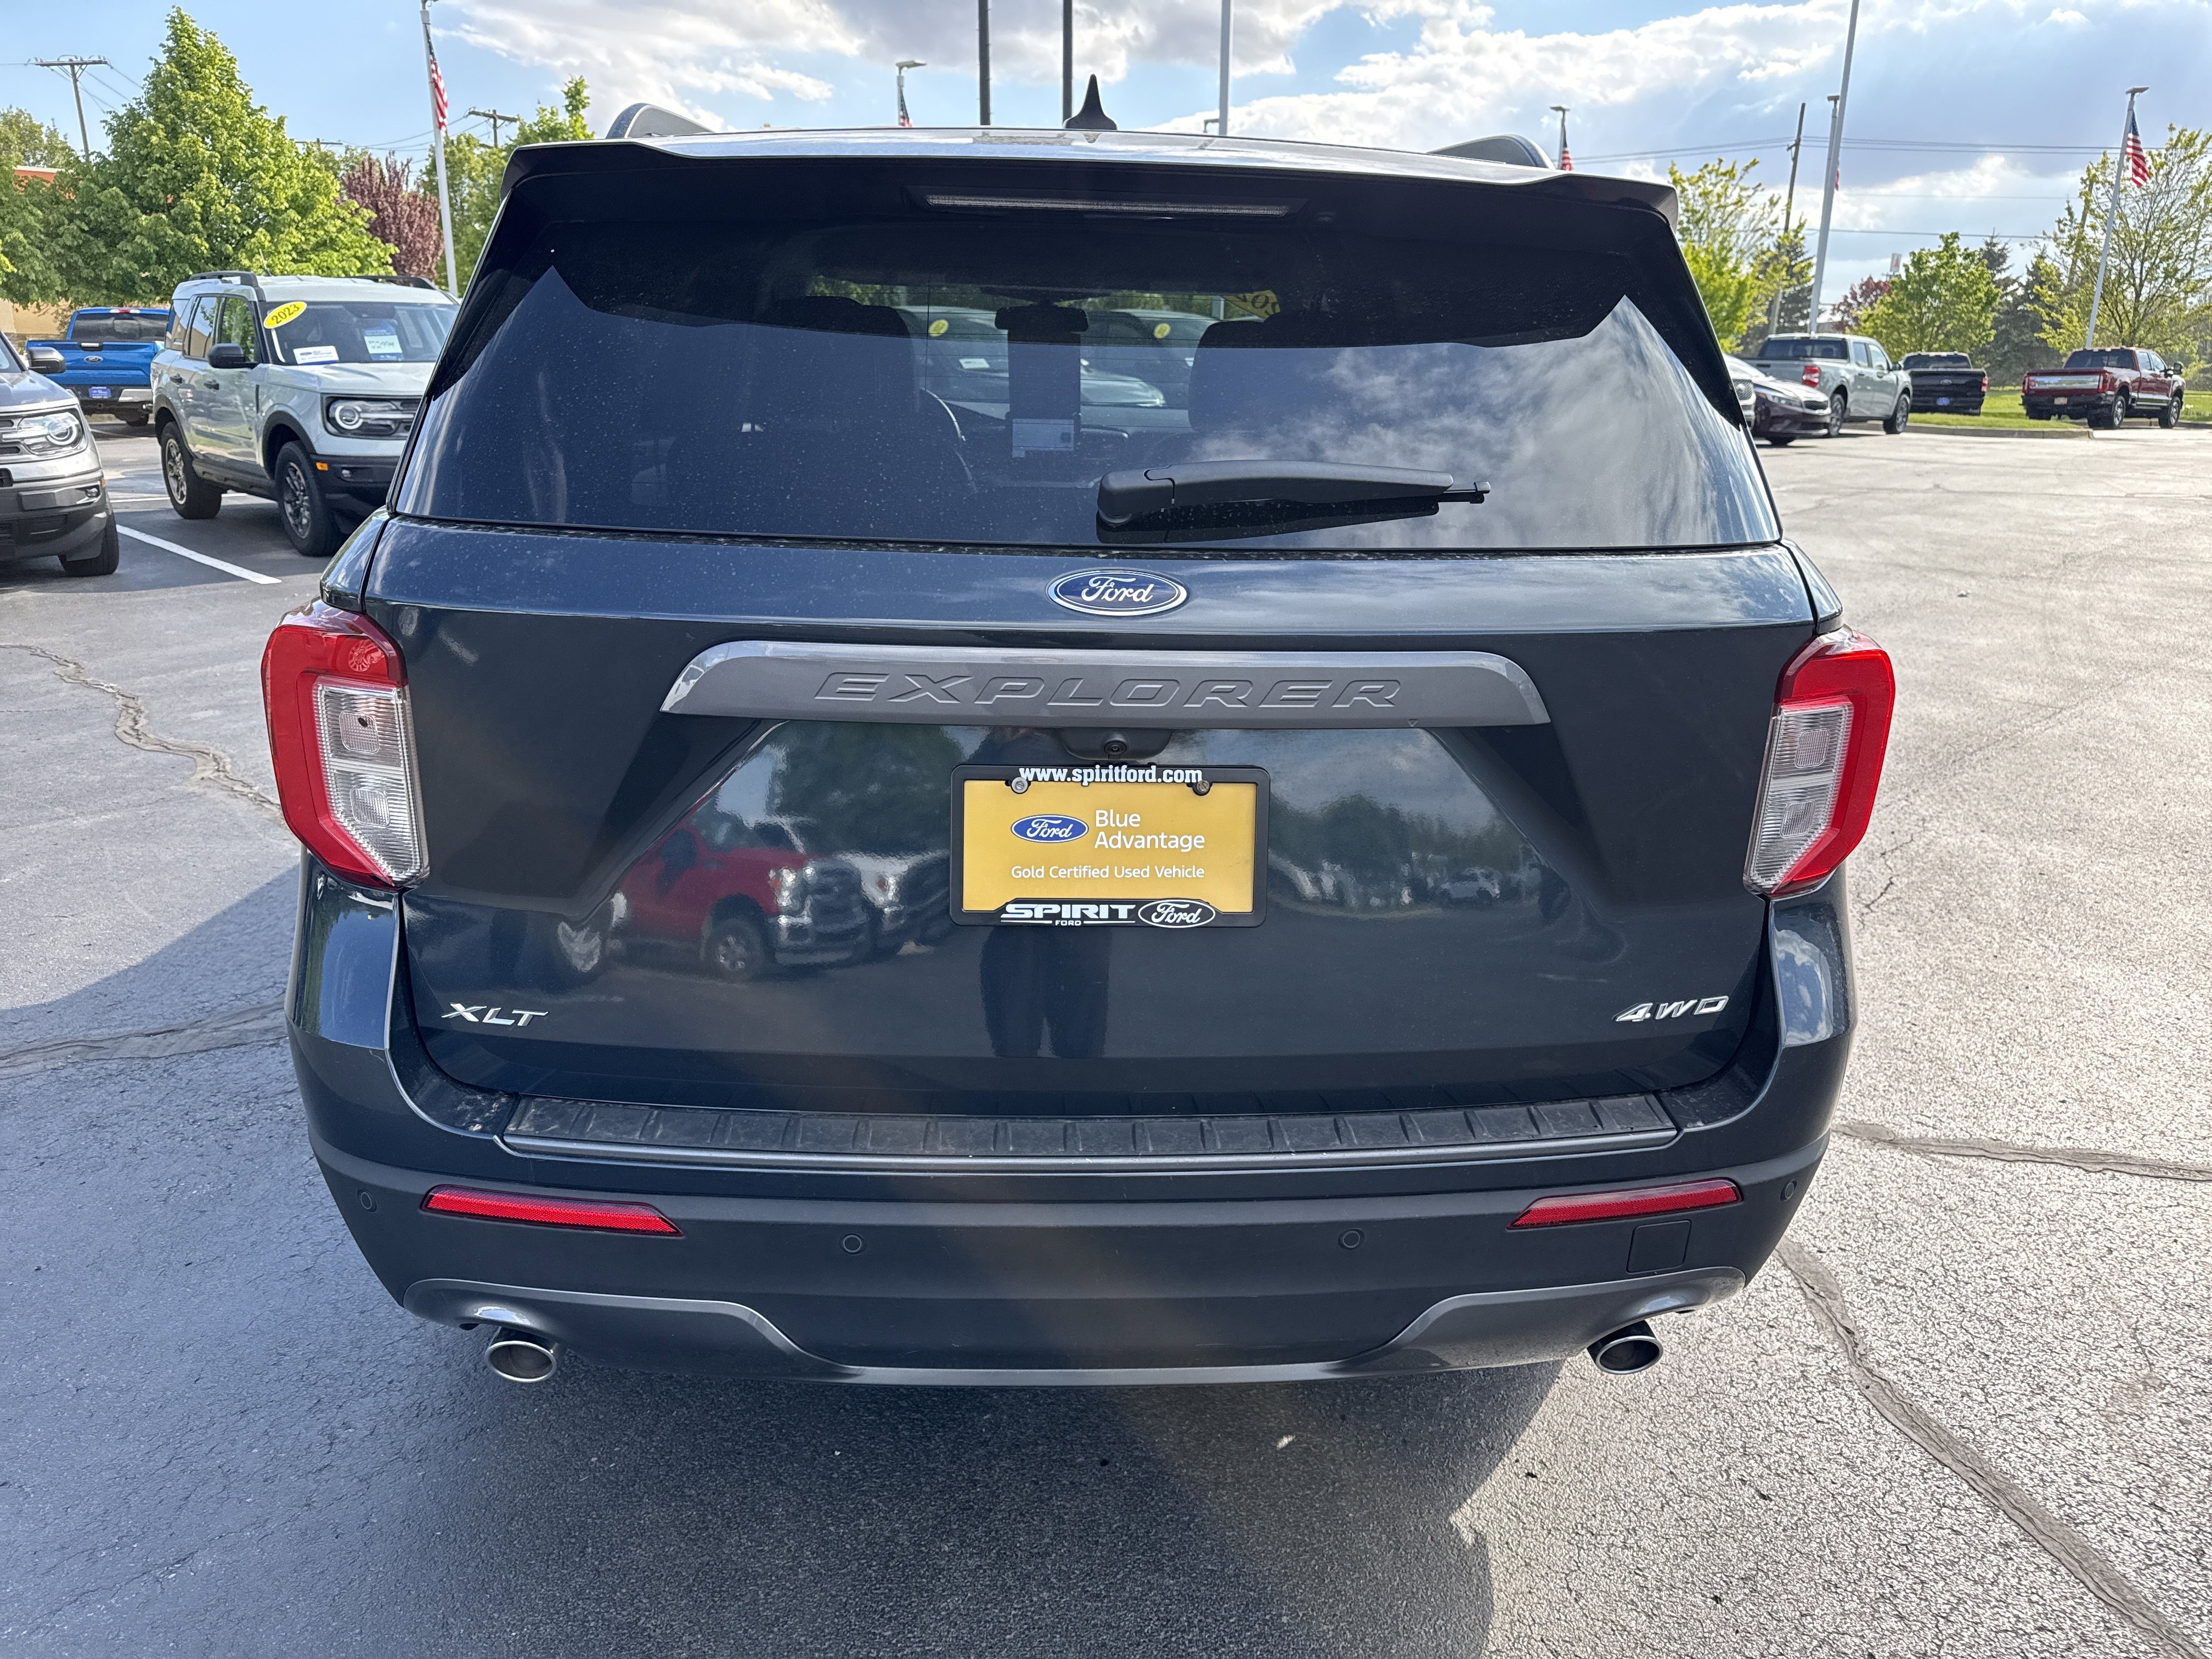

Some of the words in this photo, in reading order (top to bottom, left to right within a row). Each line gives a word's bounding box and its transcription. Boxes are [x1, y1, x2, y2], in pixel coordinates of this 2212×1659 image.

[271, 304, 300, 324] 2023
[1081, 577, 1154, 602] Ford
[814, 672, 1402, 708] EXPLORER
[1019, 765, 1203, 786] www.spiritford.com
[1026, 819, 1073, 838] Ford
[1096, 810, 1141, 827] Blue
[1094, 832, 1205, 852] Advantage
[1011, 866, 1045, 878] Gold
[1049, 866, 1109, 878] Certified
[1114, 866, 1150, 878] Used
[1155, 865, 1205, 878] Vehicle
[1001, 904, 1136, 919] SPIRIT
[1151, 902, 1202, 923] Ford
[441, 1002, 549, 1026] XLT
[1615, 995, 1729, 1022] 4WD
